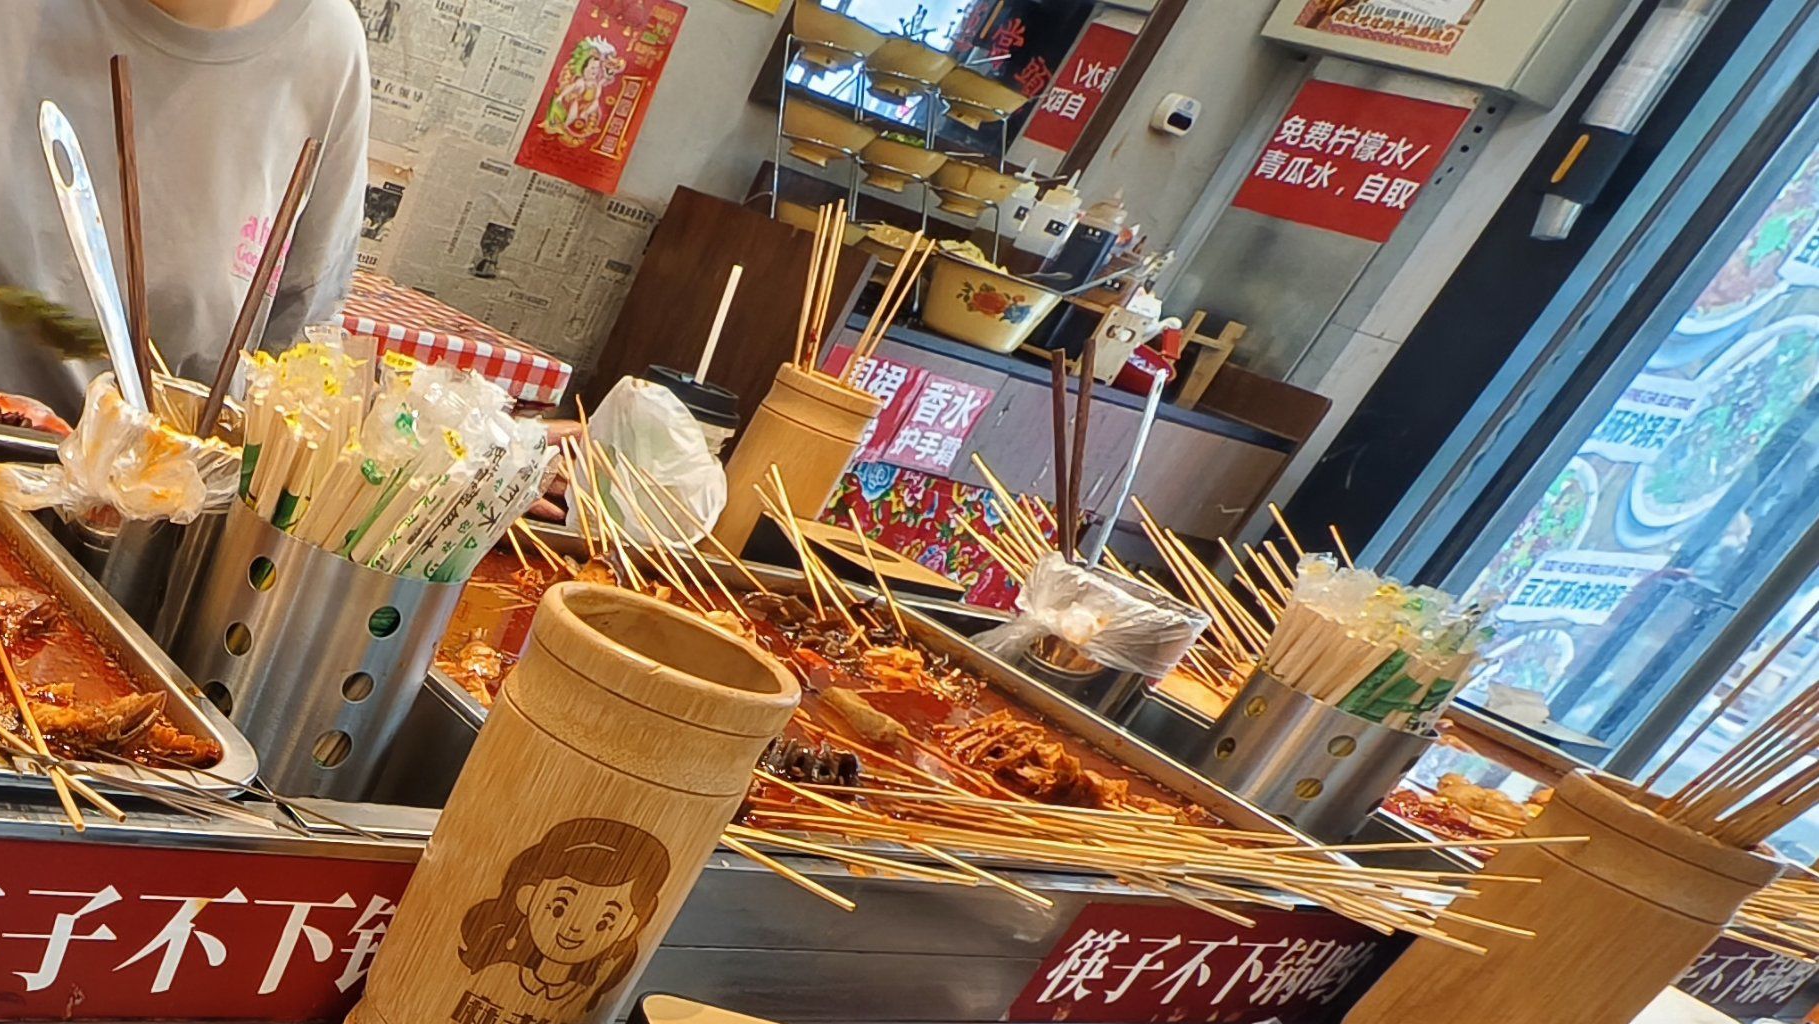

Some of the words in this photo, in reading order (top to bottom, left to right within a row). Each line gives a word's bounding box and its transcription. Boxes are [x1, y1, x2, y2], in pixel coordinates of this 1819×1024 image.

[1274, 115, 1431, 171] 免费柠檬水/
[912, 381, 982, 430] 香水
[889, 425, 963, 468] 护手霜
[1036, 928, 1378, 1005] 筷子不下锅哟
